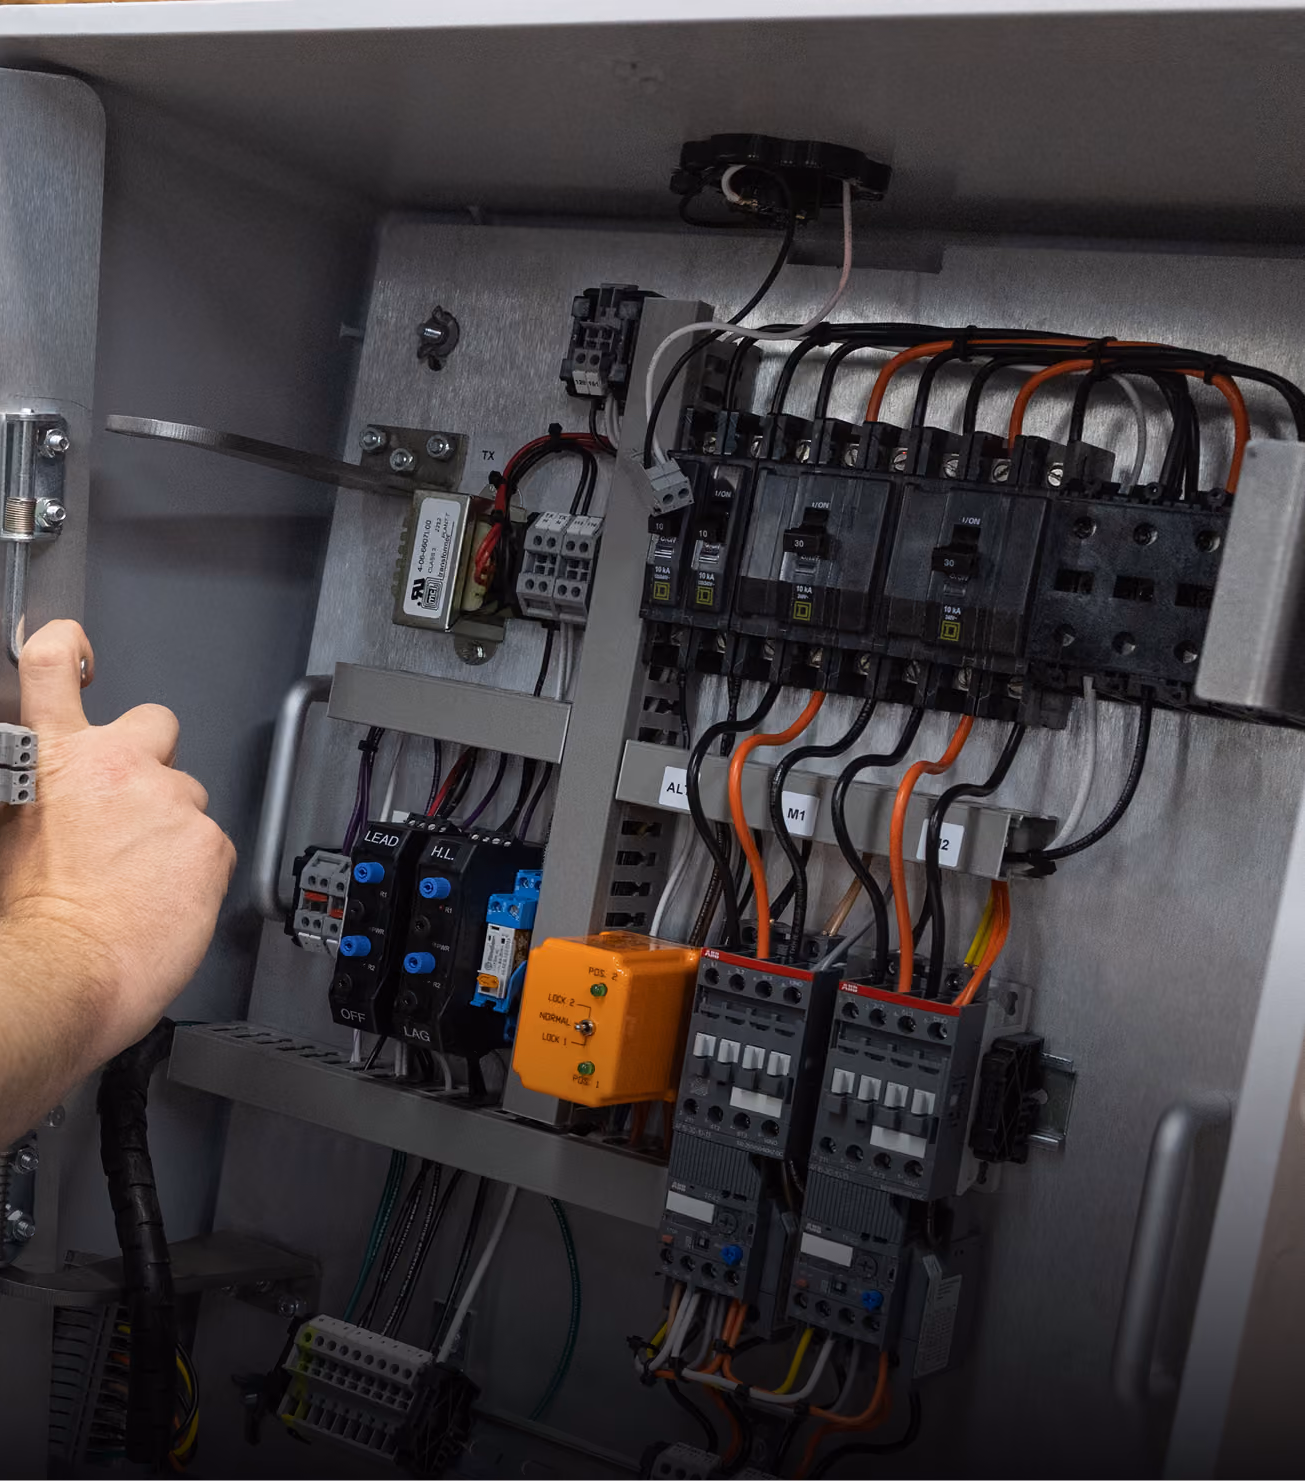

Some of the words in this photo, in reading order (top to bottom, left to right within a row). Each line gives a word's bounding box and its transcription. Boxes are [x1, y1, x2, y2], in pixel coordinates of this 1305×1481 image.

[481, 450, 495, 462] TX
[655, 522, 663, 530] 10
[699, 530, 708, 538] 10
[794, 540, 804, 548] 30
[943, 559, 955, 567] 30
[666, 782, 688, 795] AL
[787, 807, 806, 821] M1
[364, 831, 399, 847] LEAD
[431, 846, 454, 861] H.L.
[704, 950, 720, 960] ABB
[611, 973, 618, 981] 2
[841, 984, 858, 993] ABB
[547, 993, 566, 1005] LOCK
[569, 998, 575, 1007] 2
[340, 1008, 366, 1023] OFF
[539, 1012, 571, 1026] NORMAL
[403, 1025, 431, 1042] LAG
[542, 1032, 560, 1043] LOCK
